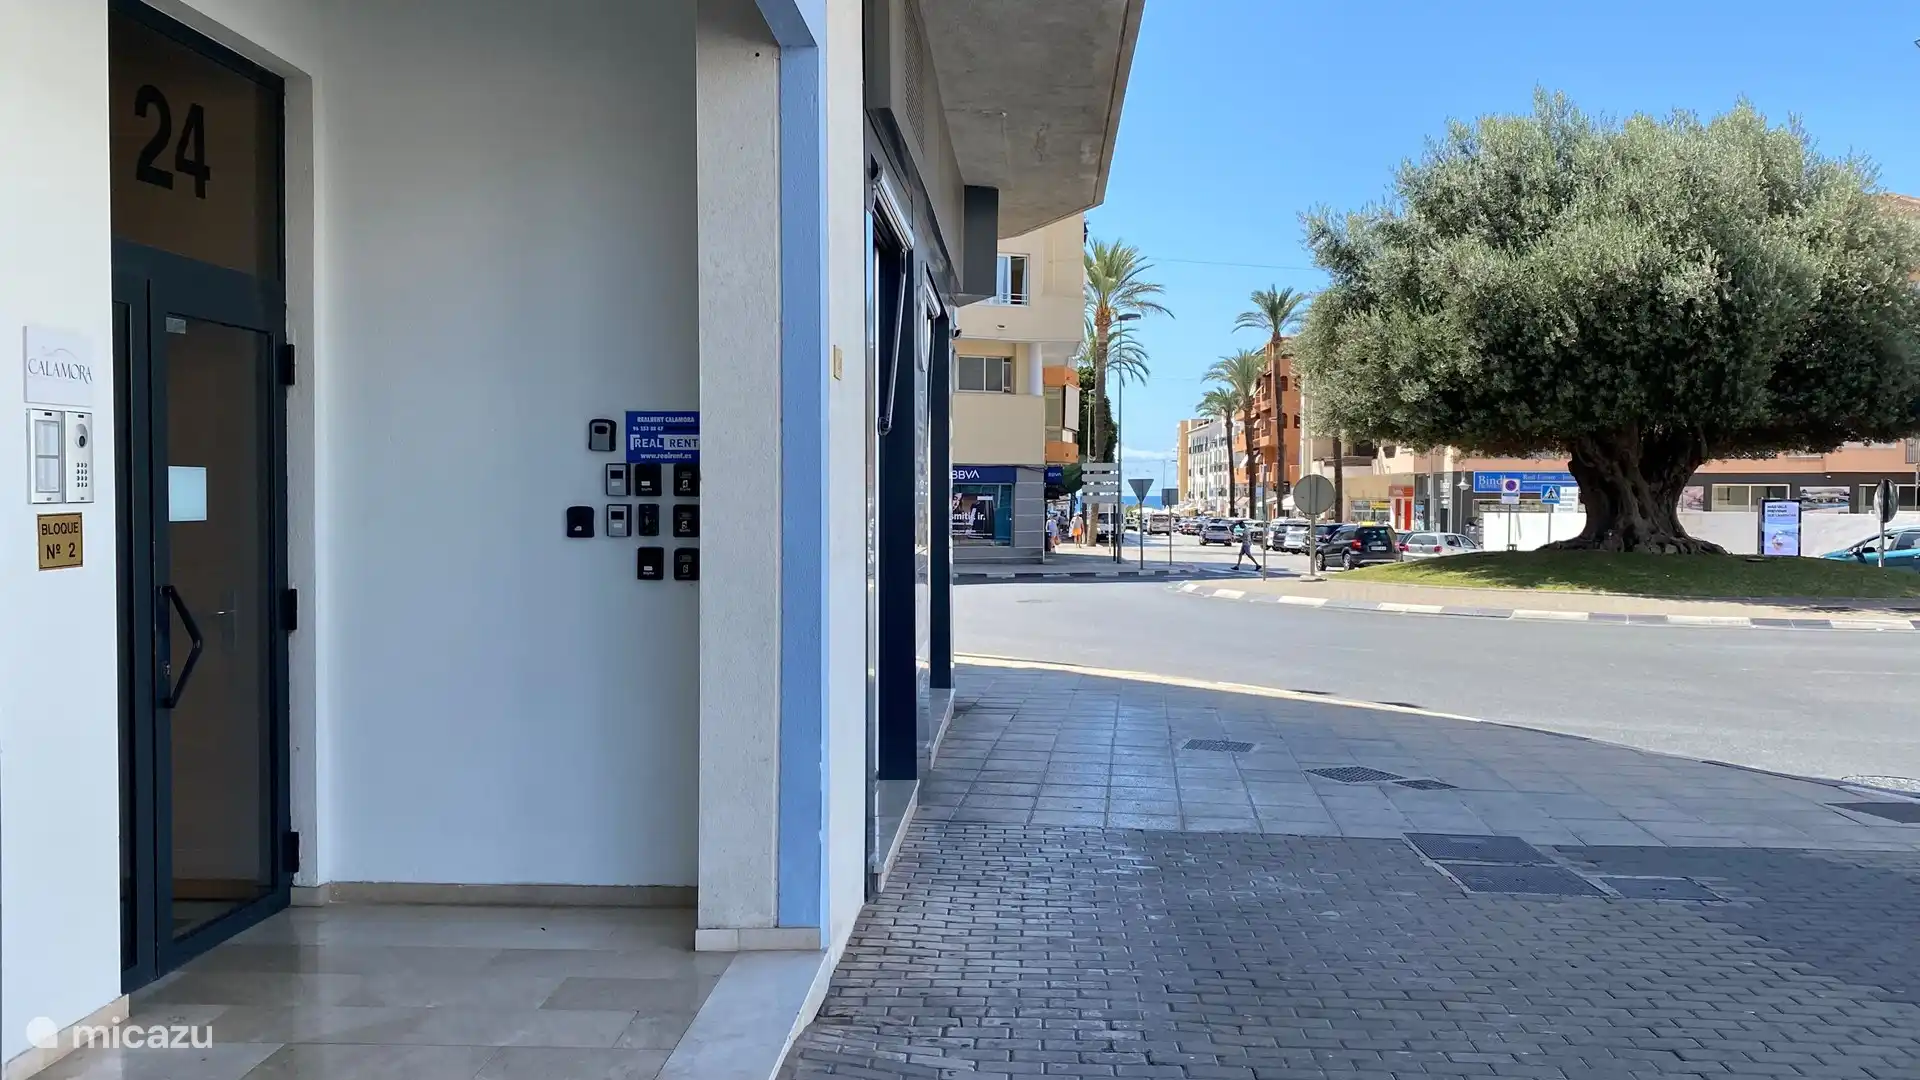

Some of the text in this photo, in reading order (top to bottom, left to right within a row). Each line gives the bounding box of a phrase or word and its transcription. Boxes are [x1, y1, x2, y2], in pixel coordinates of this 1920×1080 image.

[135, 84, 211, 199] 24
[28, 358, 92, 384] CALAMORA
[634, 438, 699, 448] REAL RENT
[977, 511, 986, 520] ir.
[42, 522, 78, 535] BLOQUE
[47, 543, 75, 559] Nº 2
